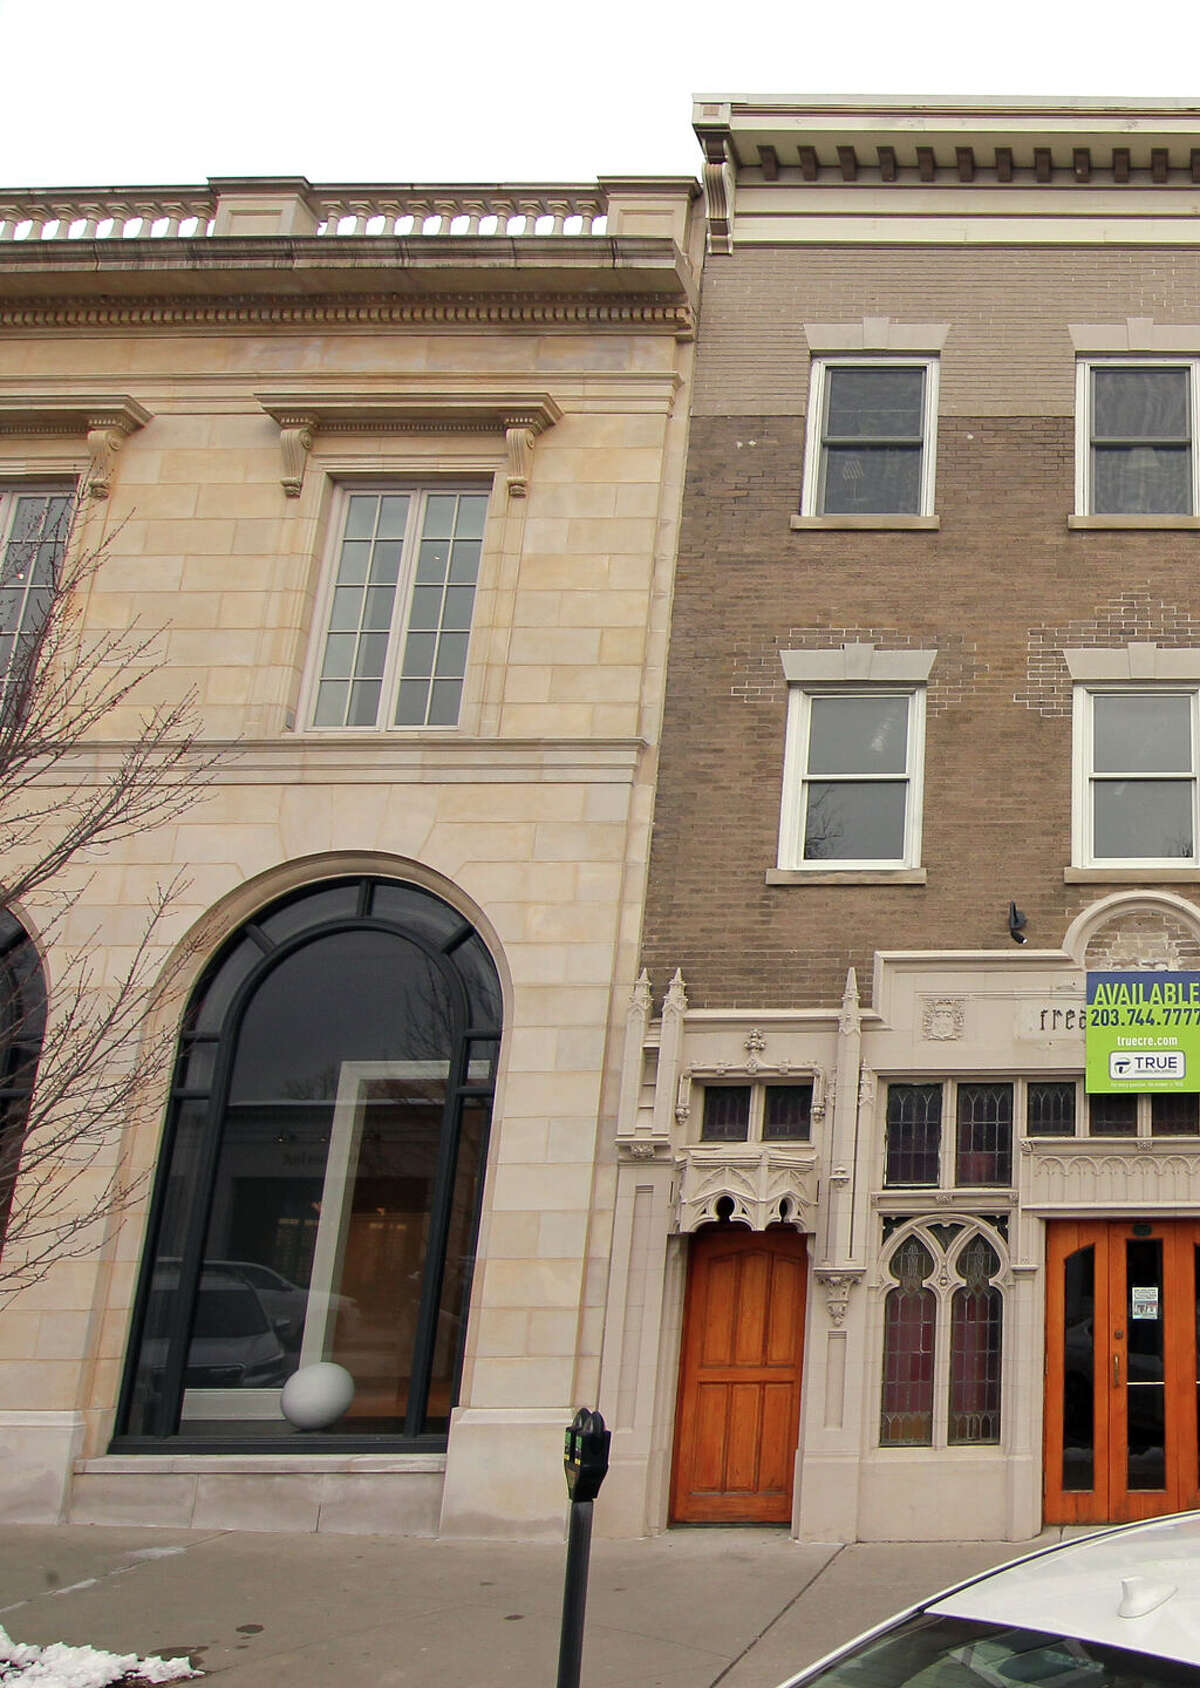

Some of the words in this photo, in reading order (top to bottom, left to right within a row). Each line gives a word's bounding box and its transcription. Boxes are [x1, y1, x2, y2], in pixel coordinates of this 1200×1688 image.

[1093, 983, 1200, 1005] AVAILABLE
[1117, 1036, 1178, 1047] truecre.com
[1134, 1056, 1177, 1069] TRUE
